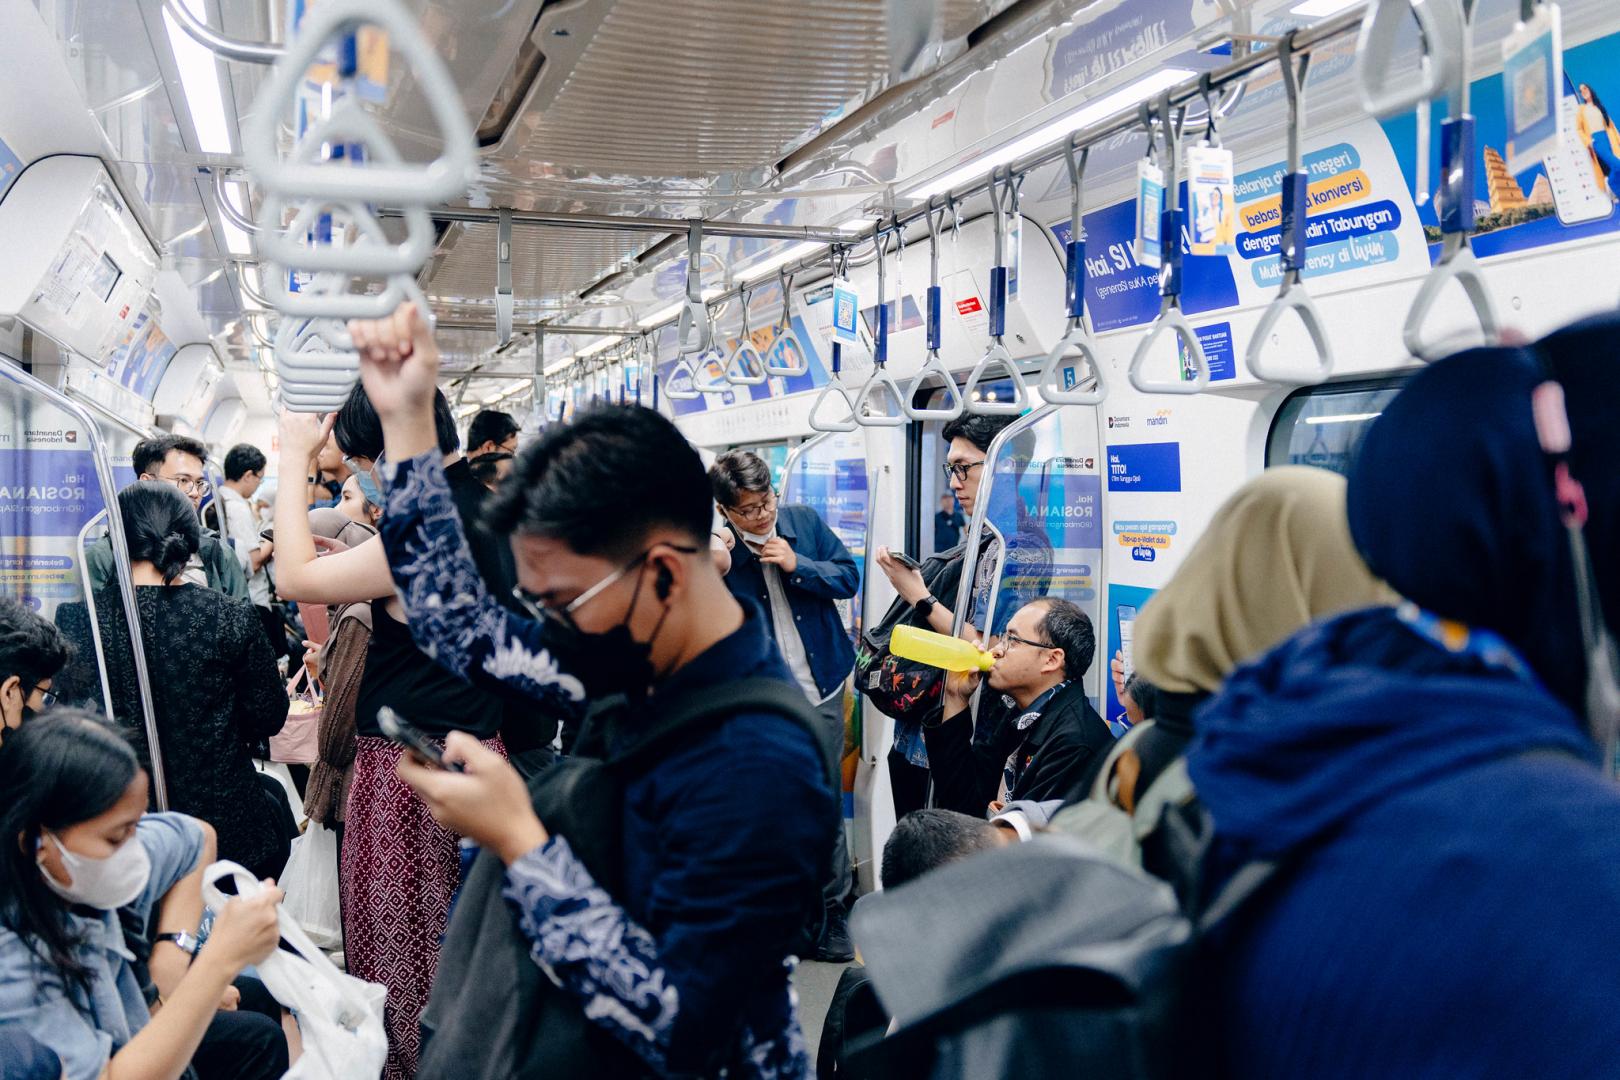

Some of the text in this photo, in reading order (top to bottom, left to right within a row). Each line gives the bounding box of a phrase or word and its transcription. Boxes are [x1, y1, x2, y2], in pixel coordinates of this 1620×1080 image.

[1233, 176, 1273, 196] Belanja
[1310, 151, 1352, 175] negeri
[1246, 208, 1280, 227] bebas
[1312, 177, 1364, 205] konversi
[1327, 208, 1392, 233] Tabungan
[1085, 254, 1115, 278] Hai,
[1108, 243, 1131, 271] SI
[1338, 247, 1351, 263] di
[1095, 280, 1128, 299] (generaSI
[1129, 275, 1148, 290] suKA
[1111, 464, 1127, 475] TITO!
